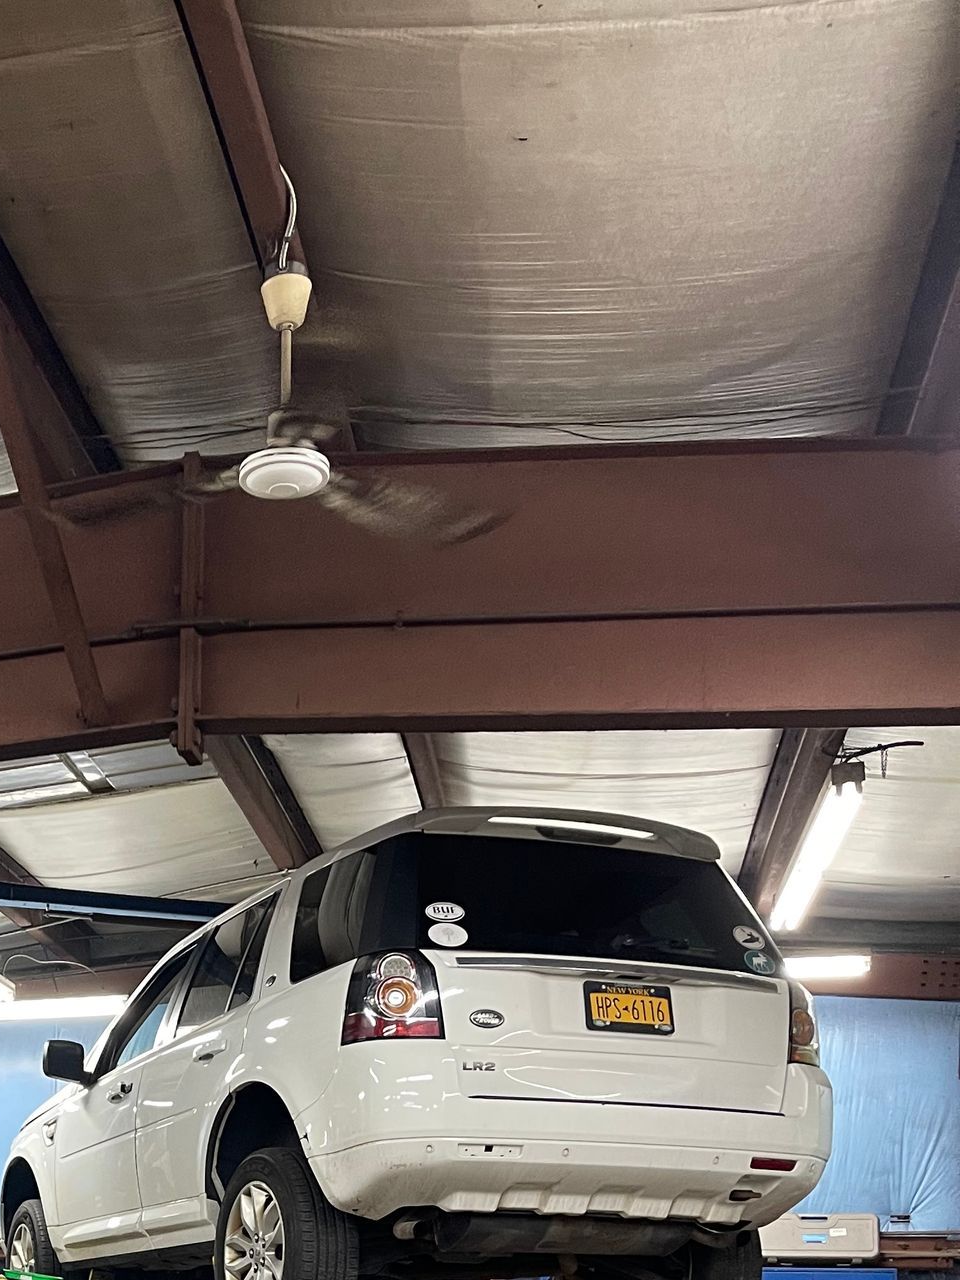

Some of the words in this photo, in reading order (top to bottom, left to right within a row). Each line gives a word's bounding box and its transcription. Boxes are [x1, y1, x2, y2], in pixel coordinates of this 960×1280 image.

[606, 986, 627, 994] NEW
[627, 987, 650, 996] YORK
[462, 1061, 496, 1072] LR2
